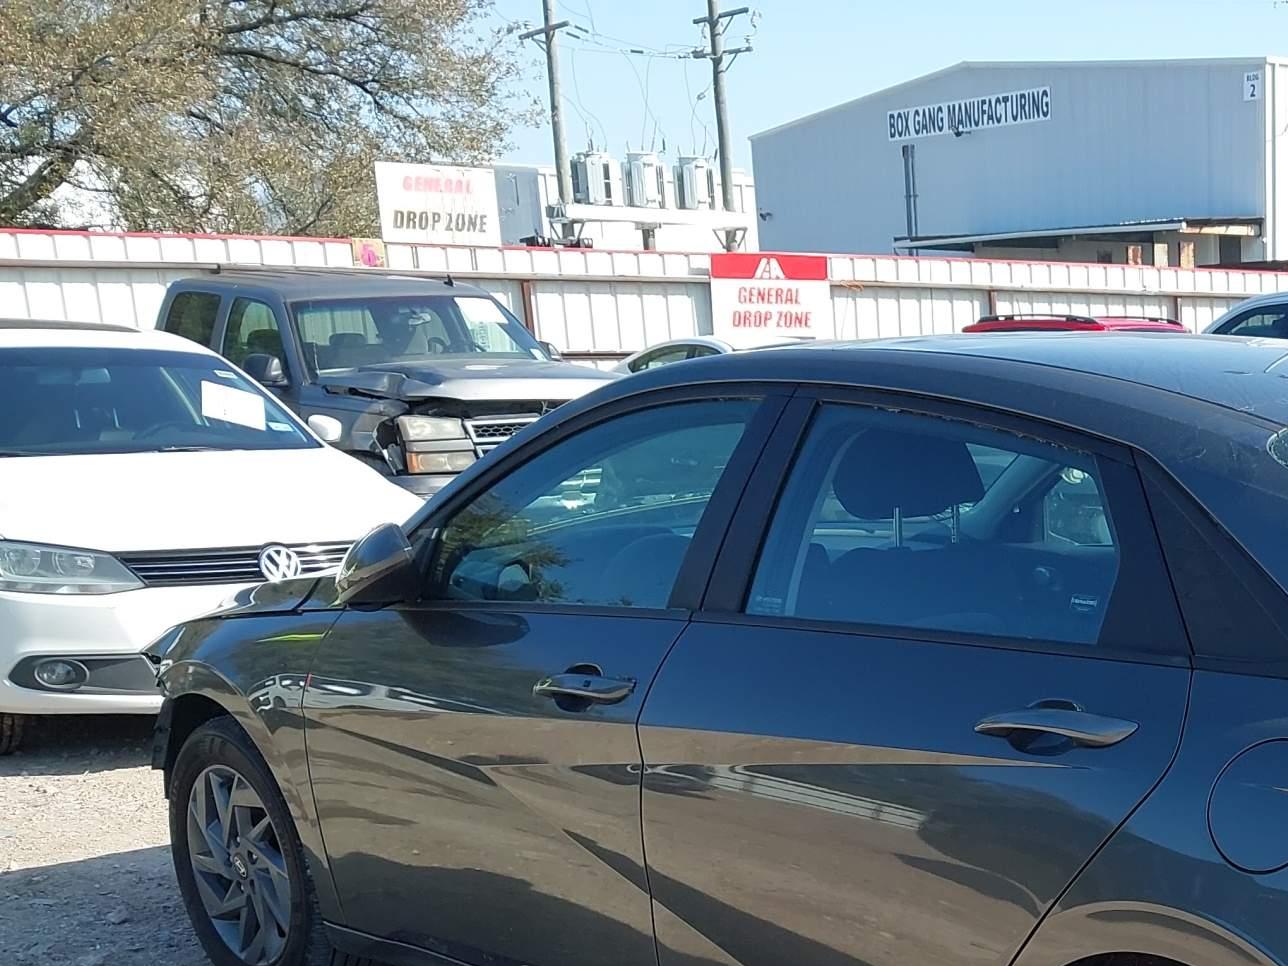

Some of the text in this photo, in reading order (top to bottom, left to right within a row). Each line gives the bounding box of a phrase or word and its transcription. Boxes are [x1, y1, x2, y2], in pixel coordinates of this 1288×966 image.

[1249, 84, 1256, 98] 2
[888, 89, 1050, 139] BOX GANG MANUFACTURING
[402, 175, 473, 194] GENERAL
[393, 210, 488, 233] DROP ZONE
[738, 286, 802, 305] GENERAL
[732, 310, 813, 329] DROP ZONE
